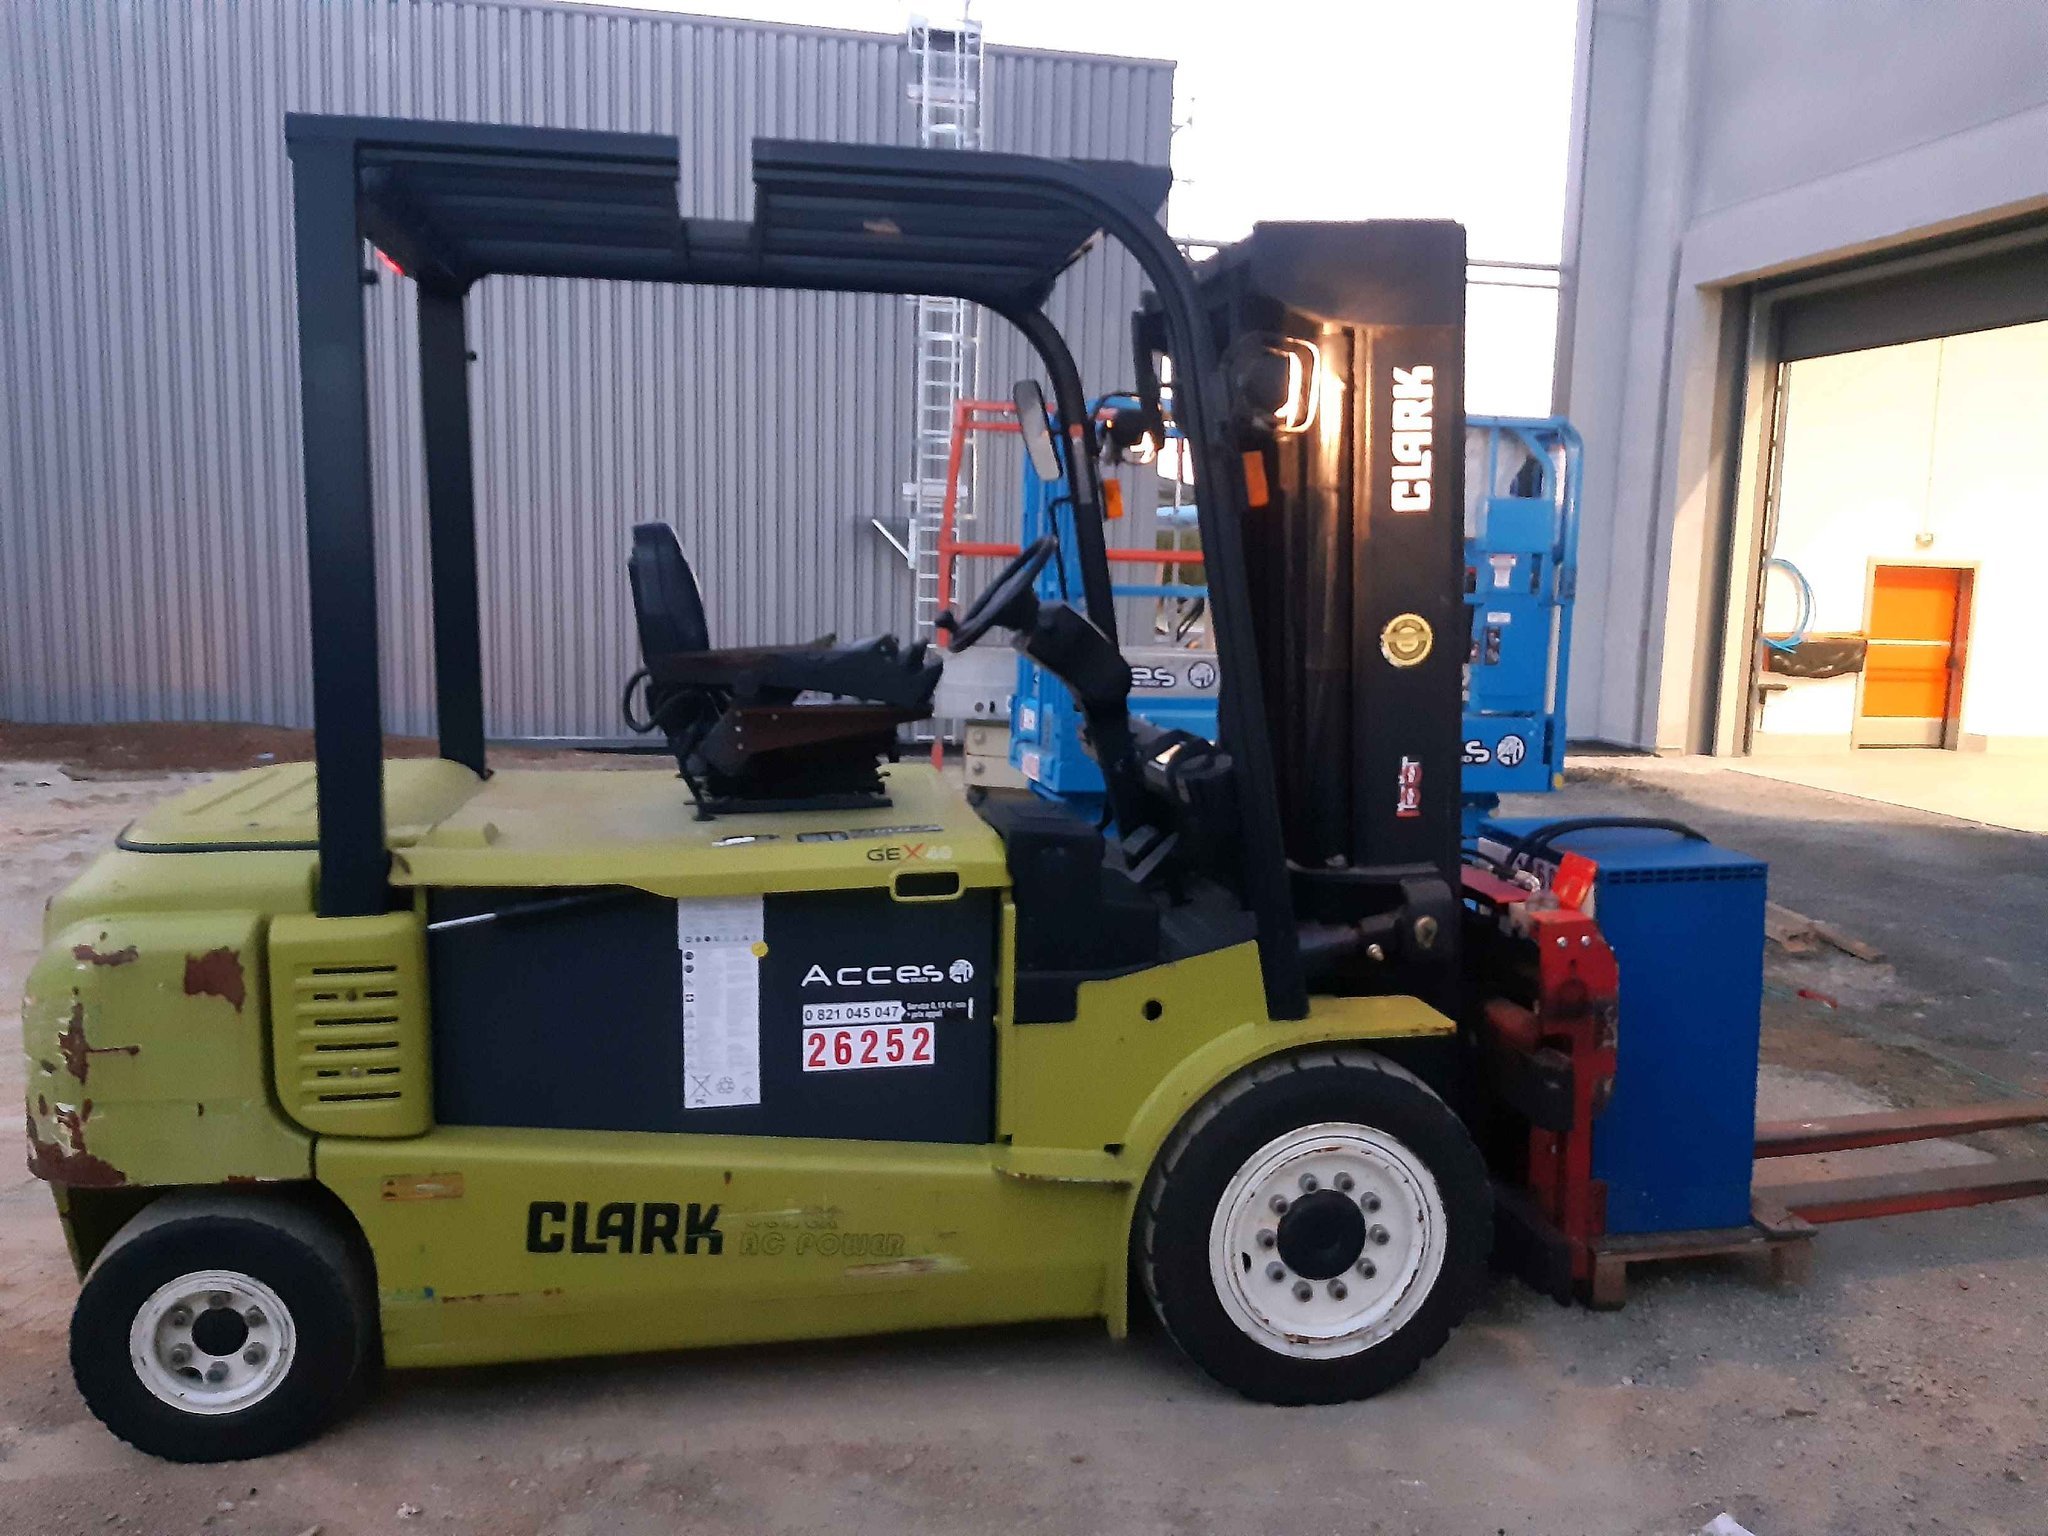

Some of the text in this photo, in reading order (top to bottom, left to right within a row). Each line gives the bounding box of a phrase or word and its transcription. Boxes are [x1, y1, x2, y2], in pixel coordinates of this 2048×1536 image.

[1391, 365, 1434, 512] CLARK
[805, 1006, 899, 1021] 0 821 045 047
[808, 1027, 930, 1067] 26252
[527, 1202, 723, 1255] CLARK
